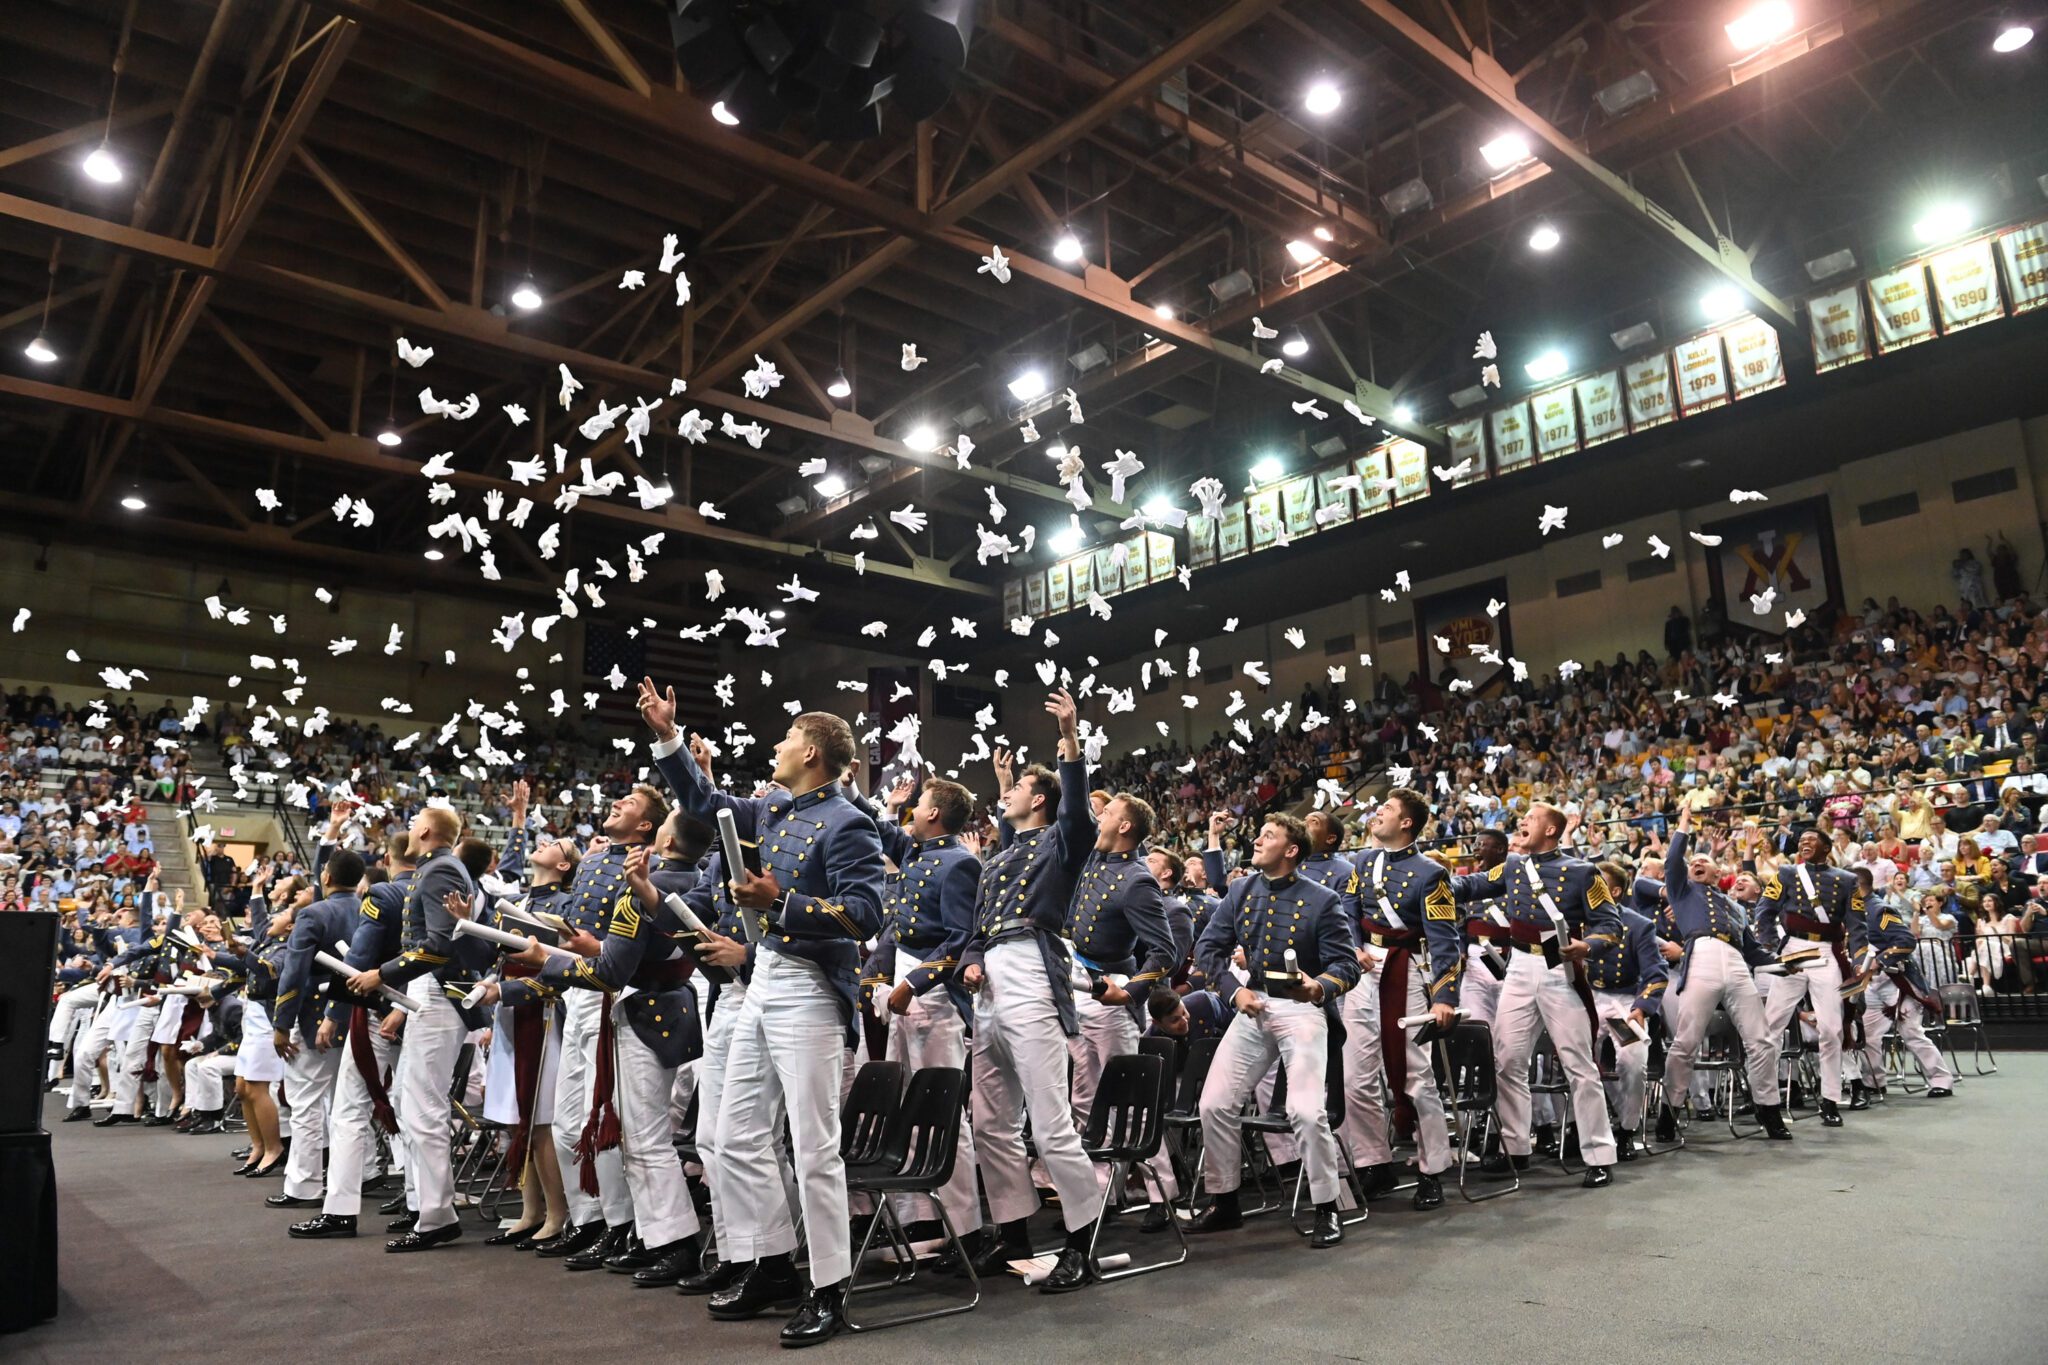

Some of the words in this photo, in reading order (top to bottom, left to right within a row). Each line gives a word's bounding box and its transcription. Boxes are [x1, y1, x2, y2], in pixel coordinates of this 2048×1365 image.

[2021, 268, 2048, 289] 199
[1952, 287, 1988, 309] 1990
[1886, 308, 1920, 330] 1990
[1824, 329, 1857, 351] 1986
[1689, 373, 1716, 392] 1979
[1640, 393, 1665, 412] 1978
[1544, 424, 1568, 442] 1977
[1502, 438, 1524, 457] 1977
